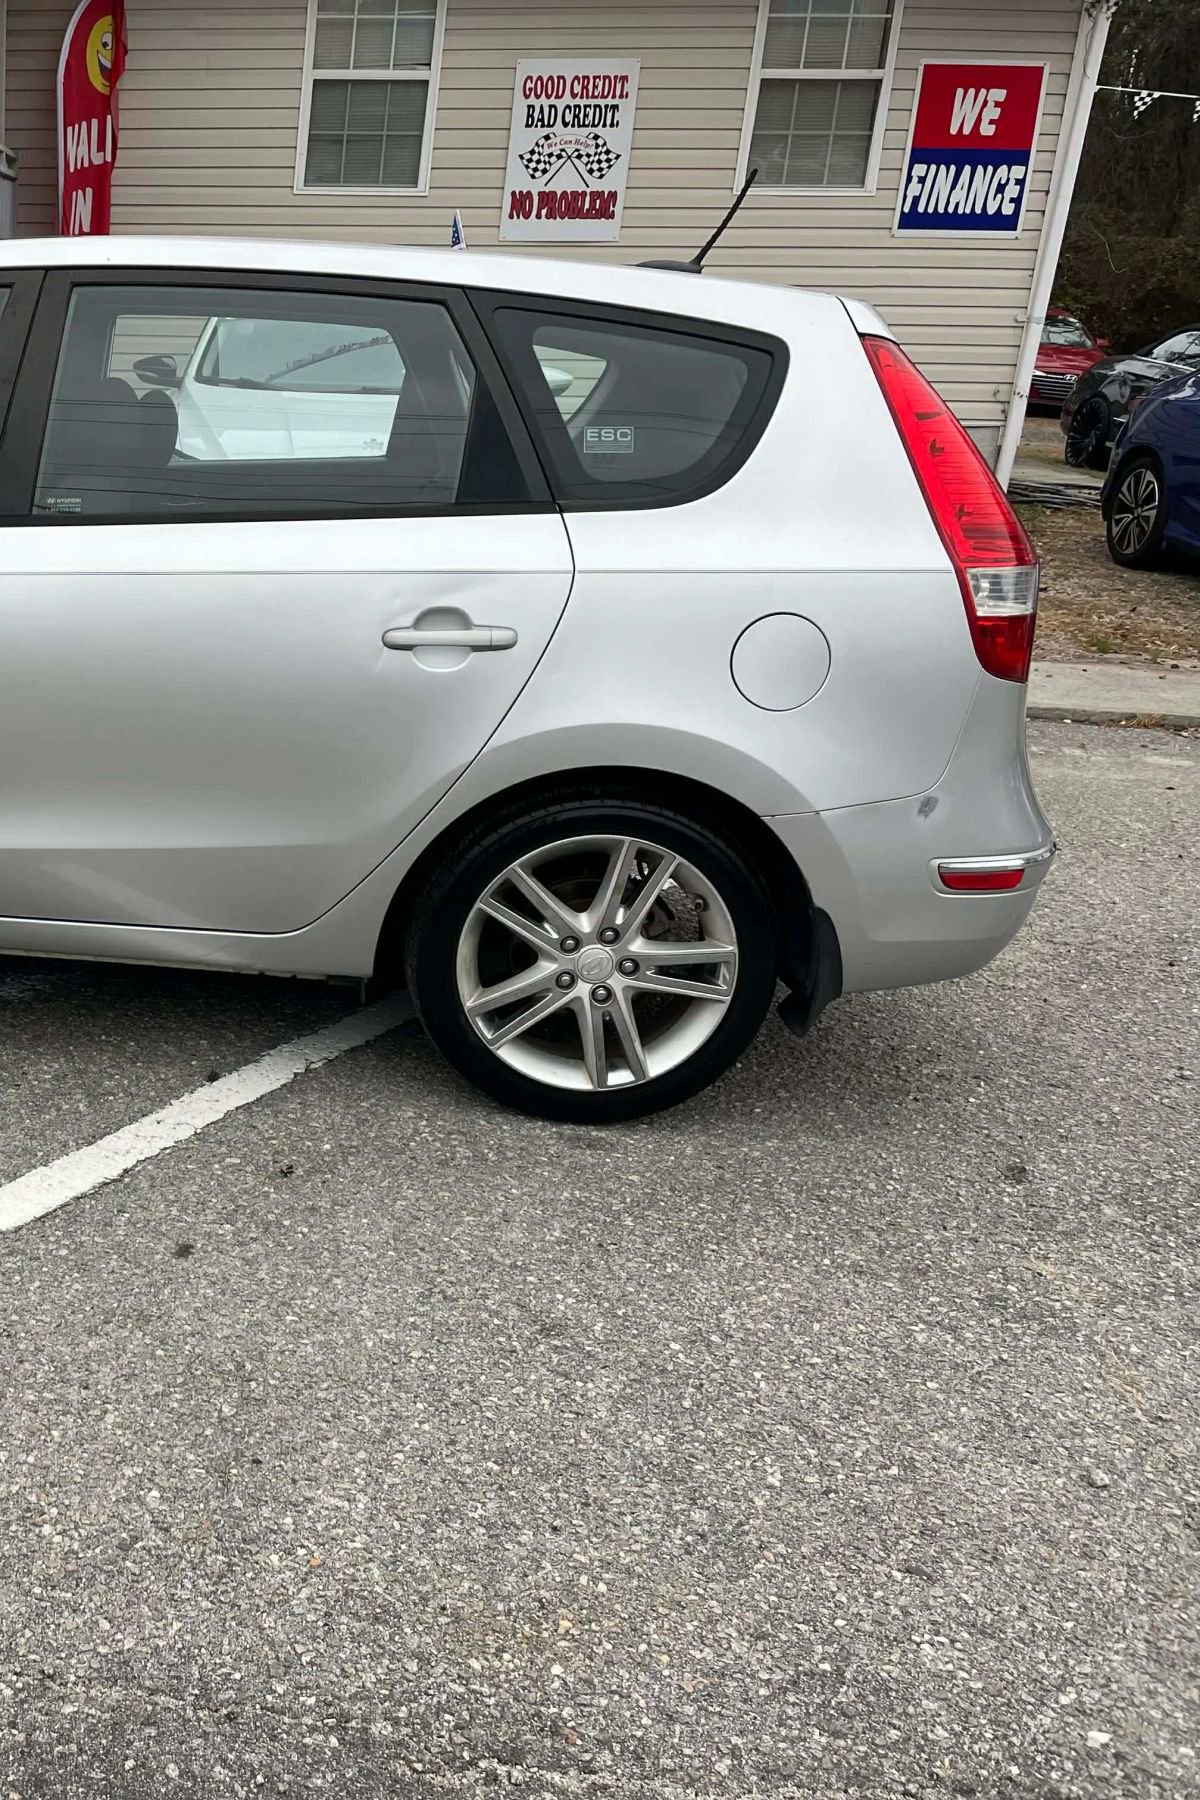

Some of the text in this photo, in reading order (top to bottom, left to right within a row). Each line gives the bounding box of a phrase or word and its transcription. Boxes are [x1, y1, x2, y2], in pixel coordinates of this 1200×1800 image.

[522, 75, 629, 100] GOOD CREDIT.
[524, 104, 620, 129] BAD CREDIT.
[949, 87, 1007, 136] WE
[559, 138, 573, 146] Can
[902, 163, 1027, 216] FINANCE
[69, 186, 93, 236] IN
[508, 189, 618, 220] NO PROBLEM!
[586, 428, 632, 441] ESC
